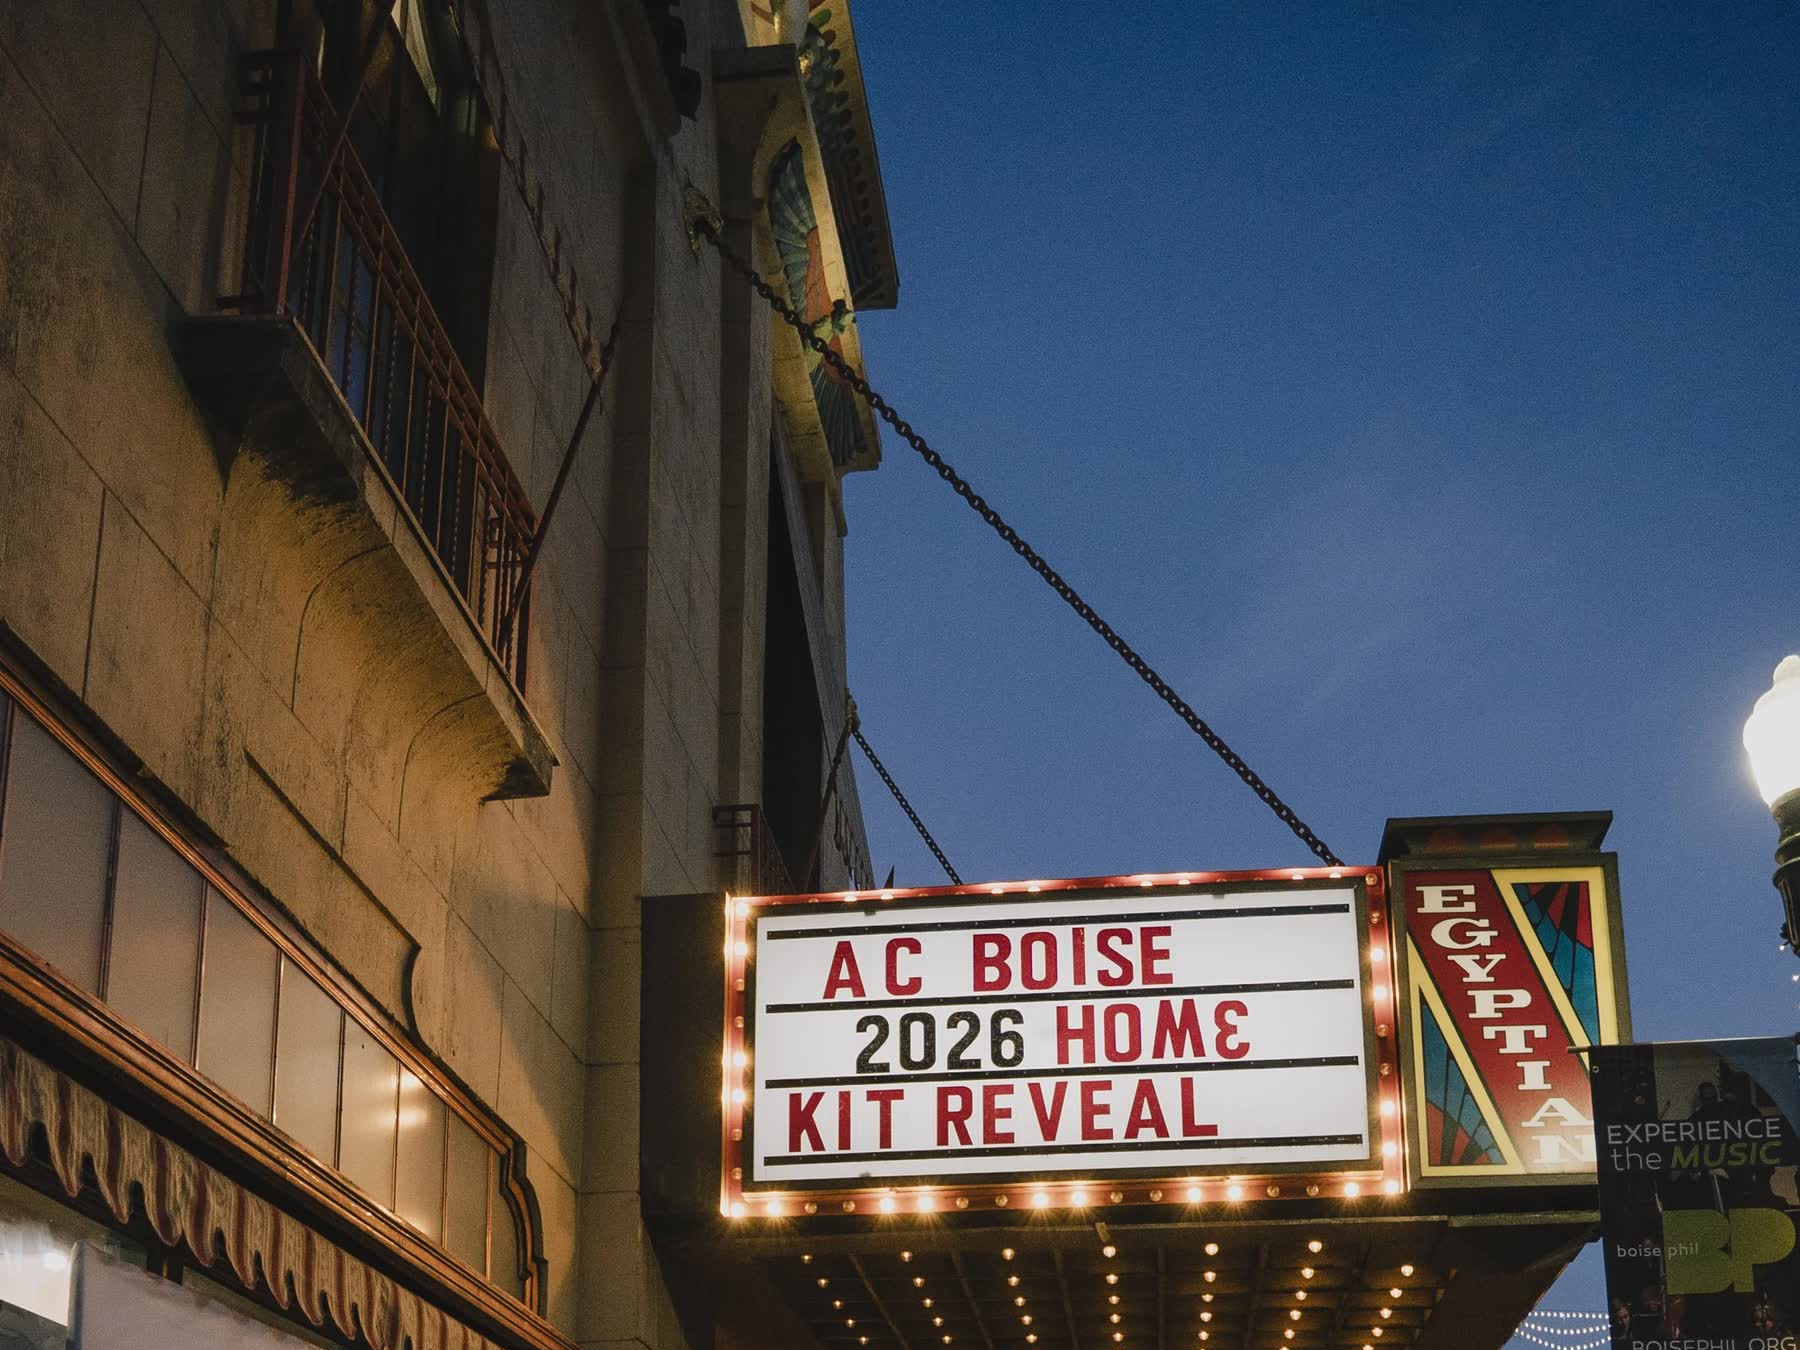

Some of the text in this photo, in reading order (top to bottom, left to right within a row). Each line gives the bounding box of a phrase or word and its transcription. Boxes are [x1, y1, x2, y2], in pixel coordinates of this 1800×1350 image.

[973, 926, 1174, 992] BOISE
[854, 1008, 1025, 1073] 2026
[1415, 885, 1598, 1164] EGYPTIAN
[788, 1076, 1218, 1152] KIT REVEAL
[1607, 1118, 1782, 1145] EXPERIENCE
[1610, 1141, 1783, 1171] the MUSIC
[1617, 1240, 1699, 1260] boise phil
